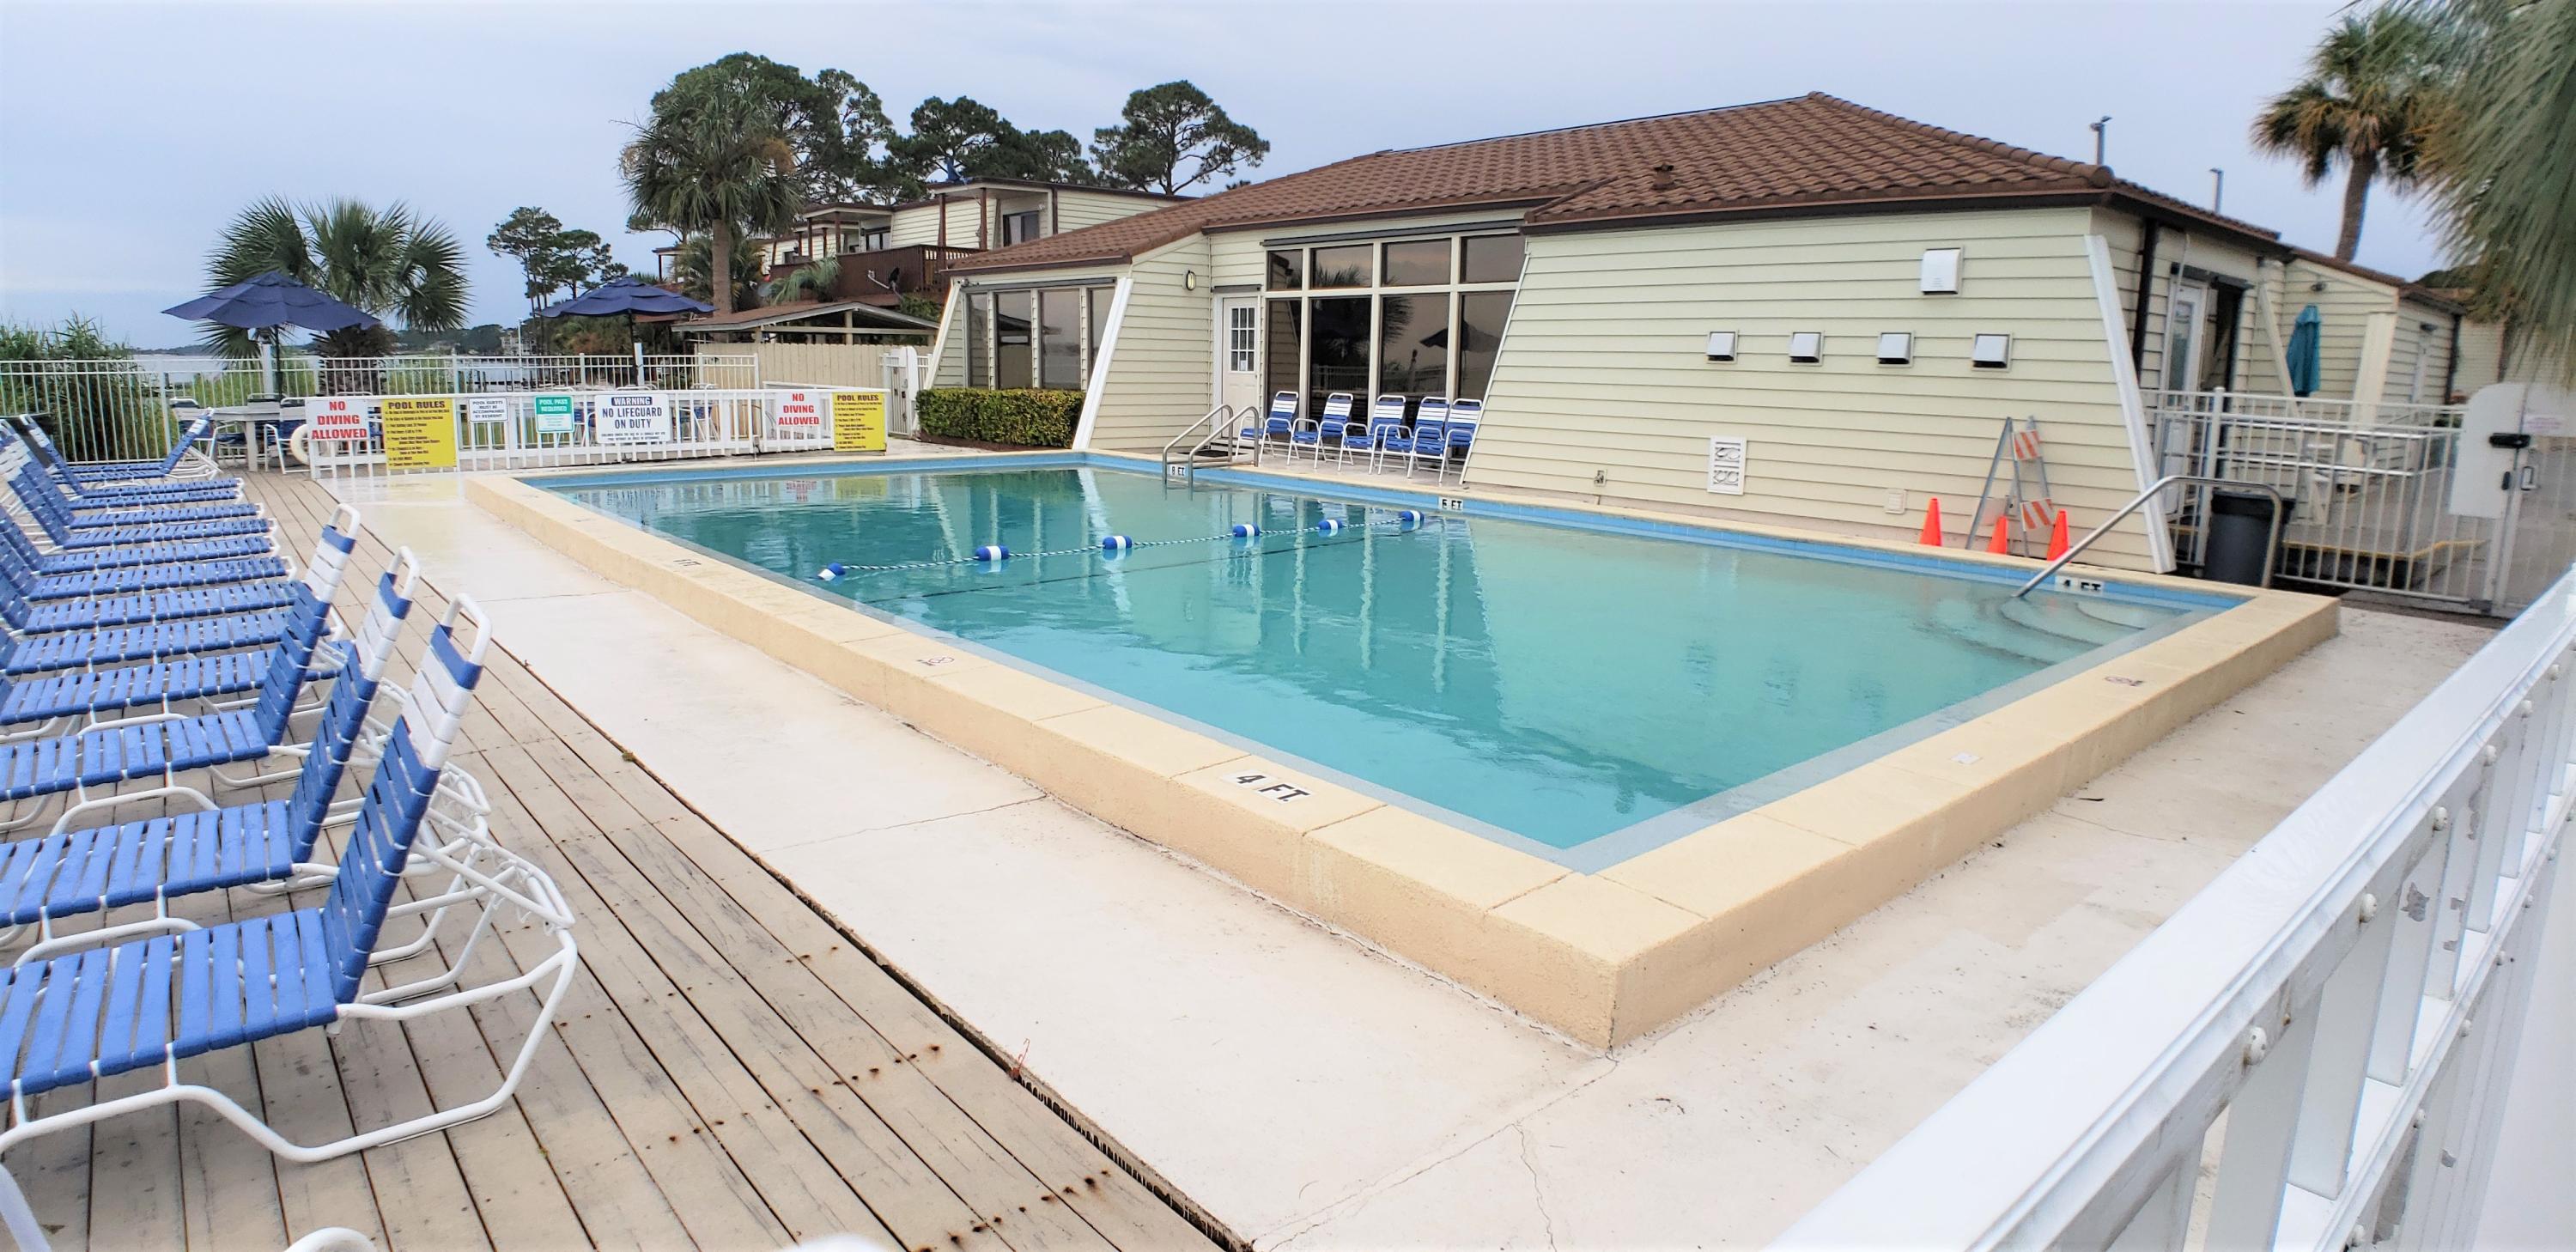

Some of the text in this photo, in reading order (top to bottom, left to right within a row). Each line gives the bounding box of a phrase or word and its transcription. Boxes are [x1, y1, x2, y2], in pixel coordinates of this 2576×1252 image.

[329, 401, 346, 410] NO
[614, 397, 651, 405] WARNING
[603, 407, 662, 417] NO LIFEGUARD
[317, 415, 360, 425] DIVING
[615, 418, 651, 429] ON DUTY
[779, 416, 819, 425] ALLOWED
[311, 428, 368, 439] ALLOWED
[1236, 775, 1267, 784] 4
